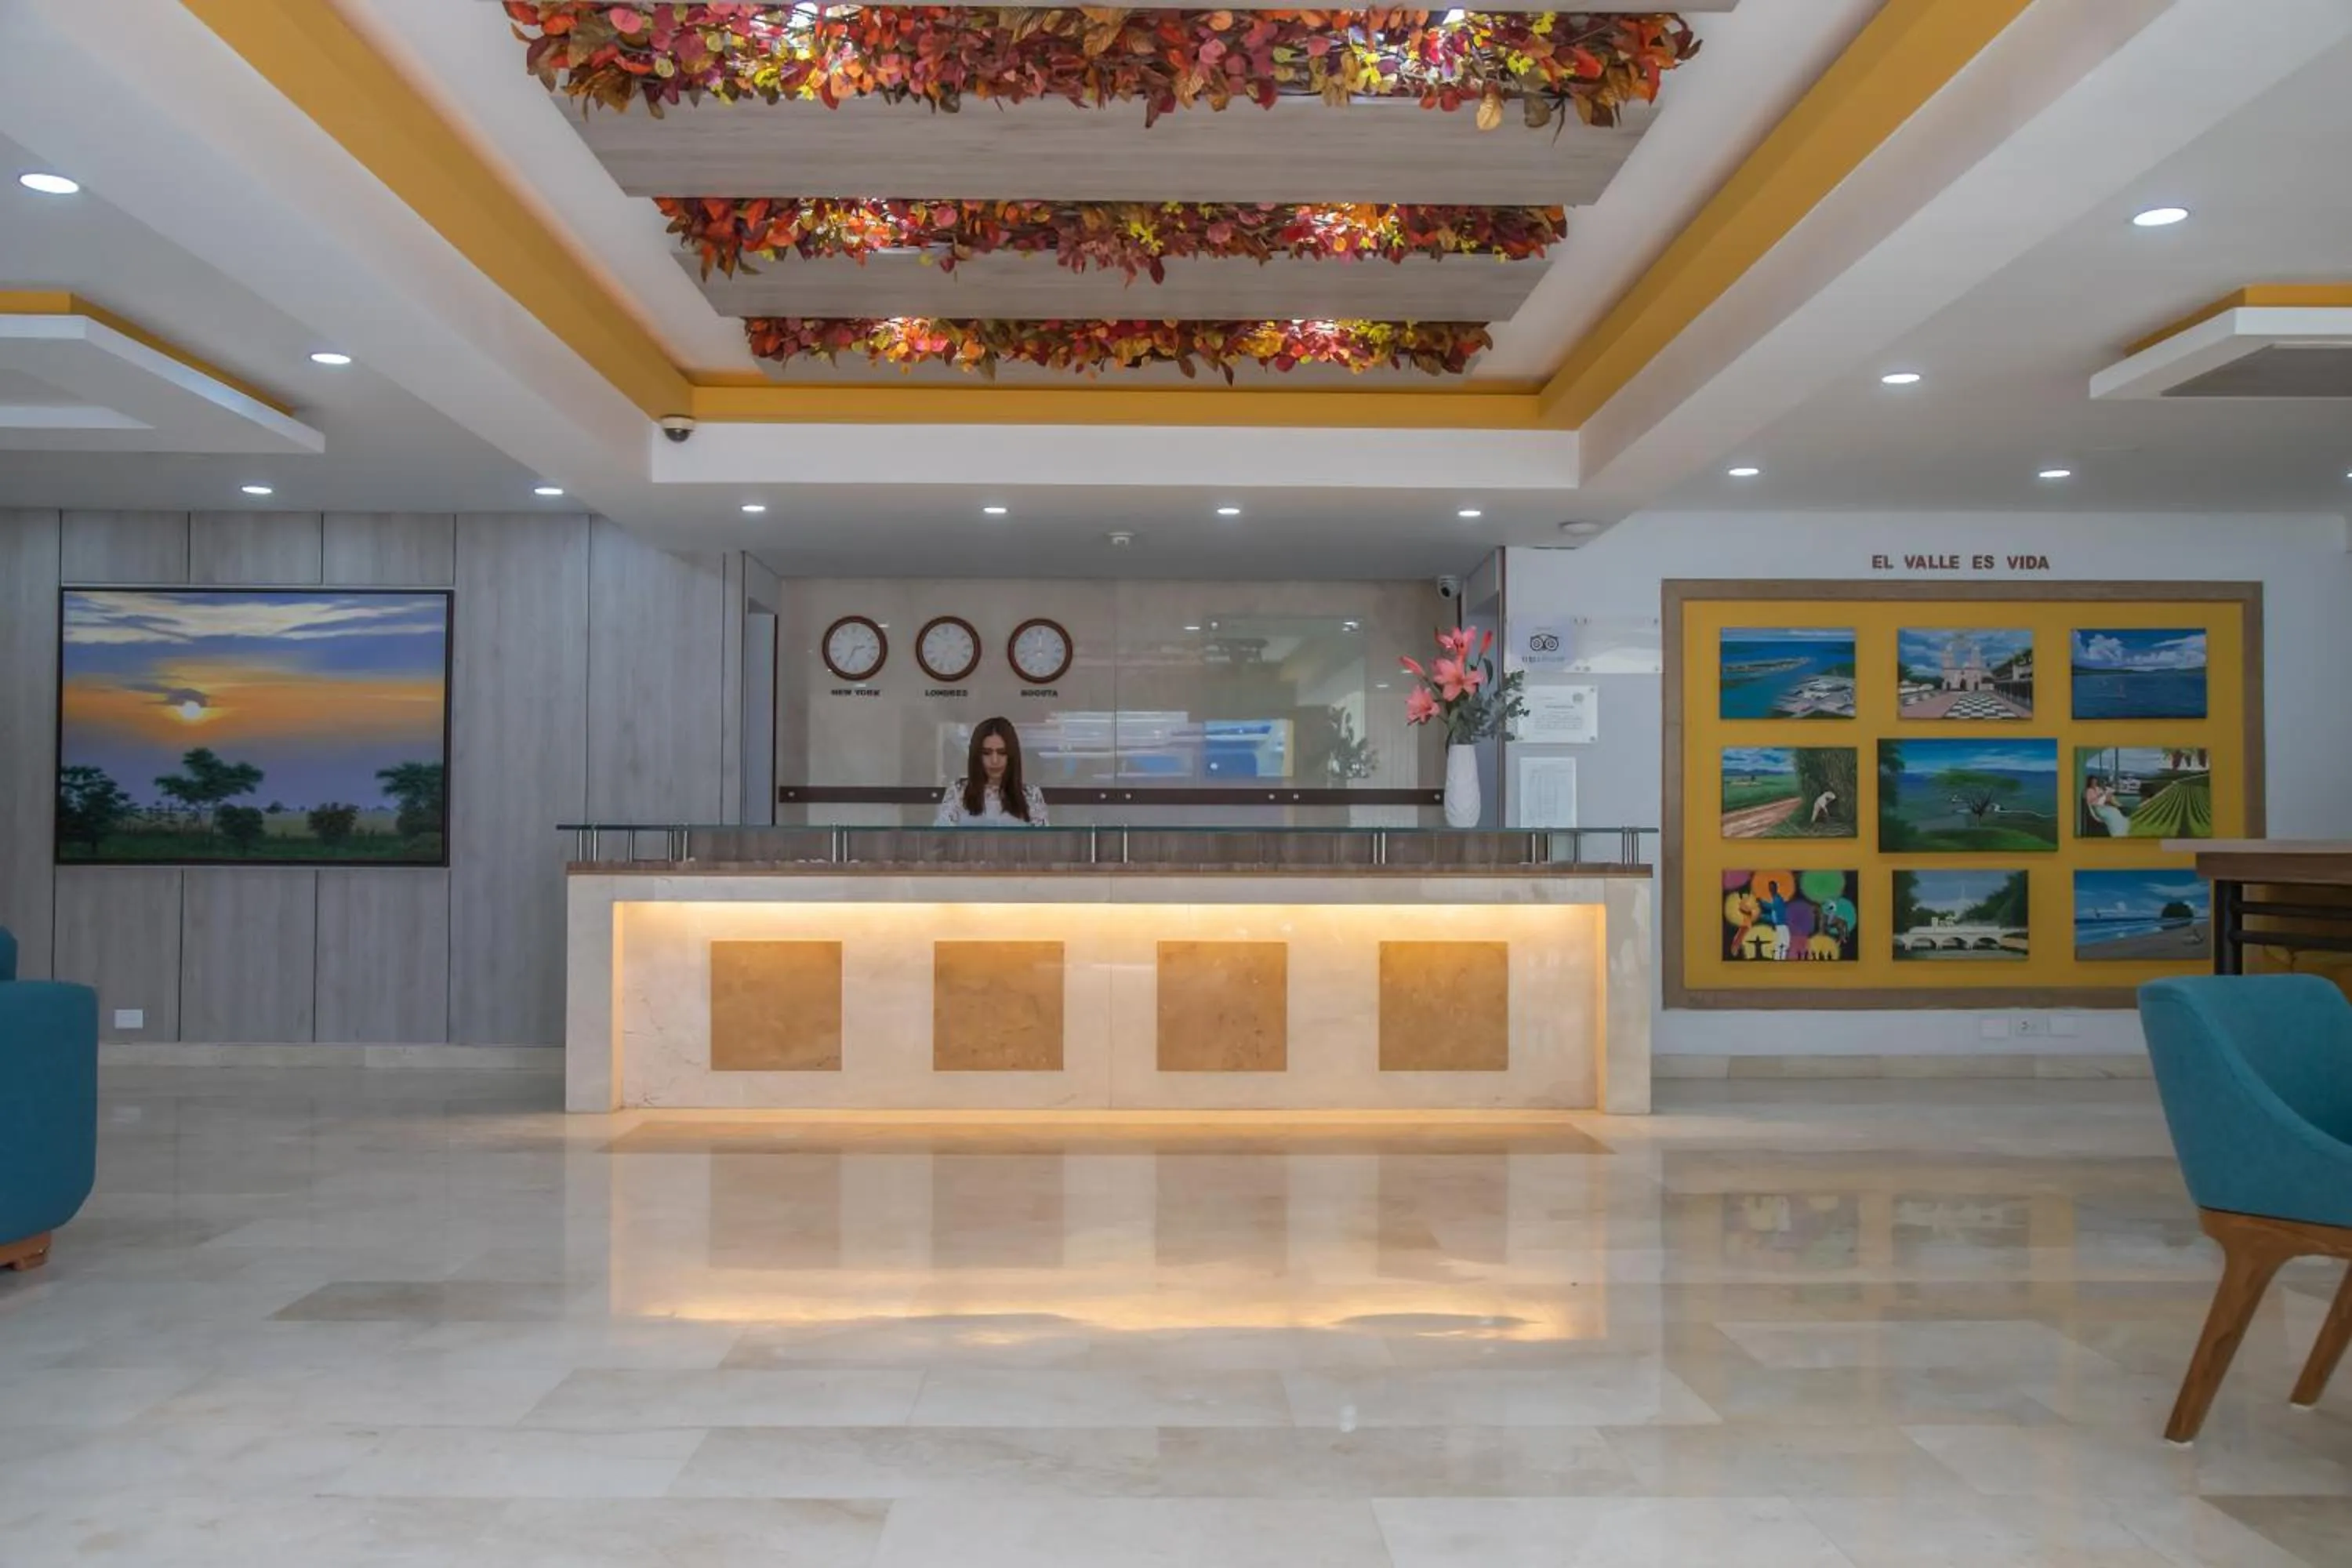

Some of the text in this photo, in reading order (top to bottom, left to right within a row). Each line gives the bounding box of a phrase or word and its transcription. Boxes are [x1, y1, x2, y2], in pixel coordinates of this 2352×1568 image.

[1871, 555, 2050, 570] EL VALLE ES VIDA
